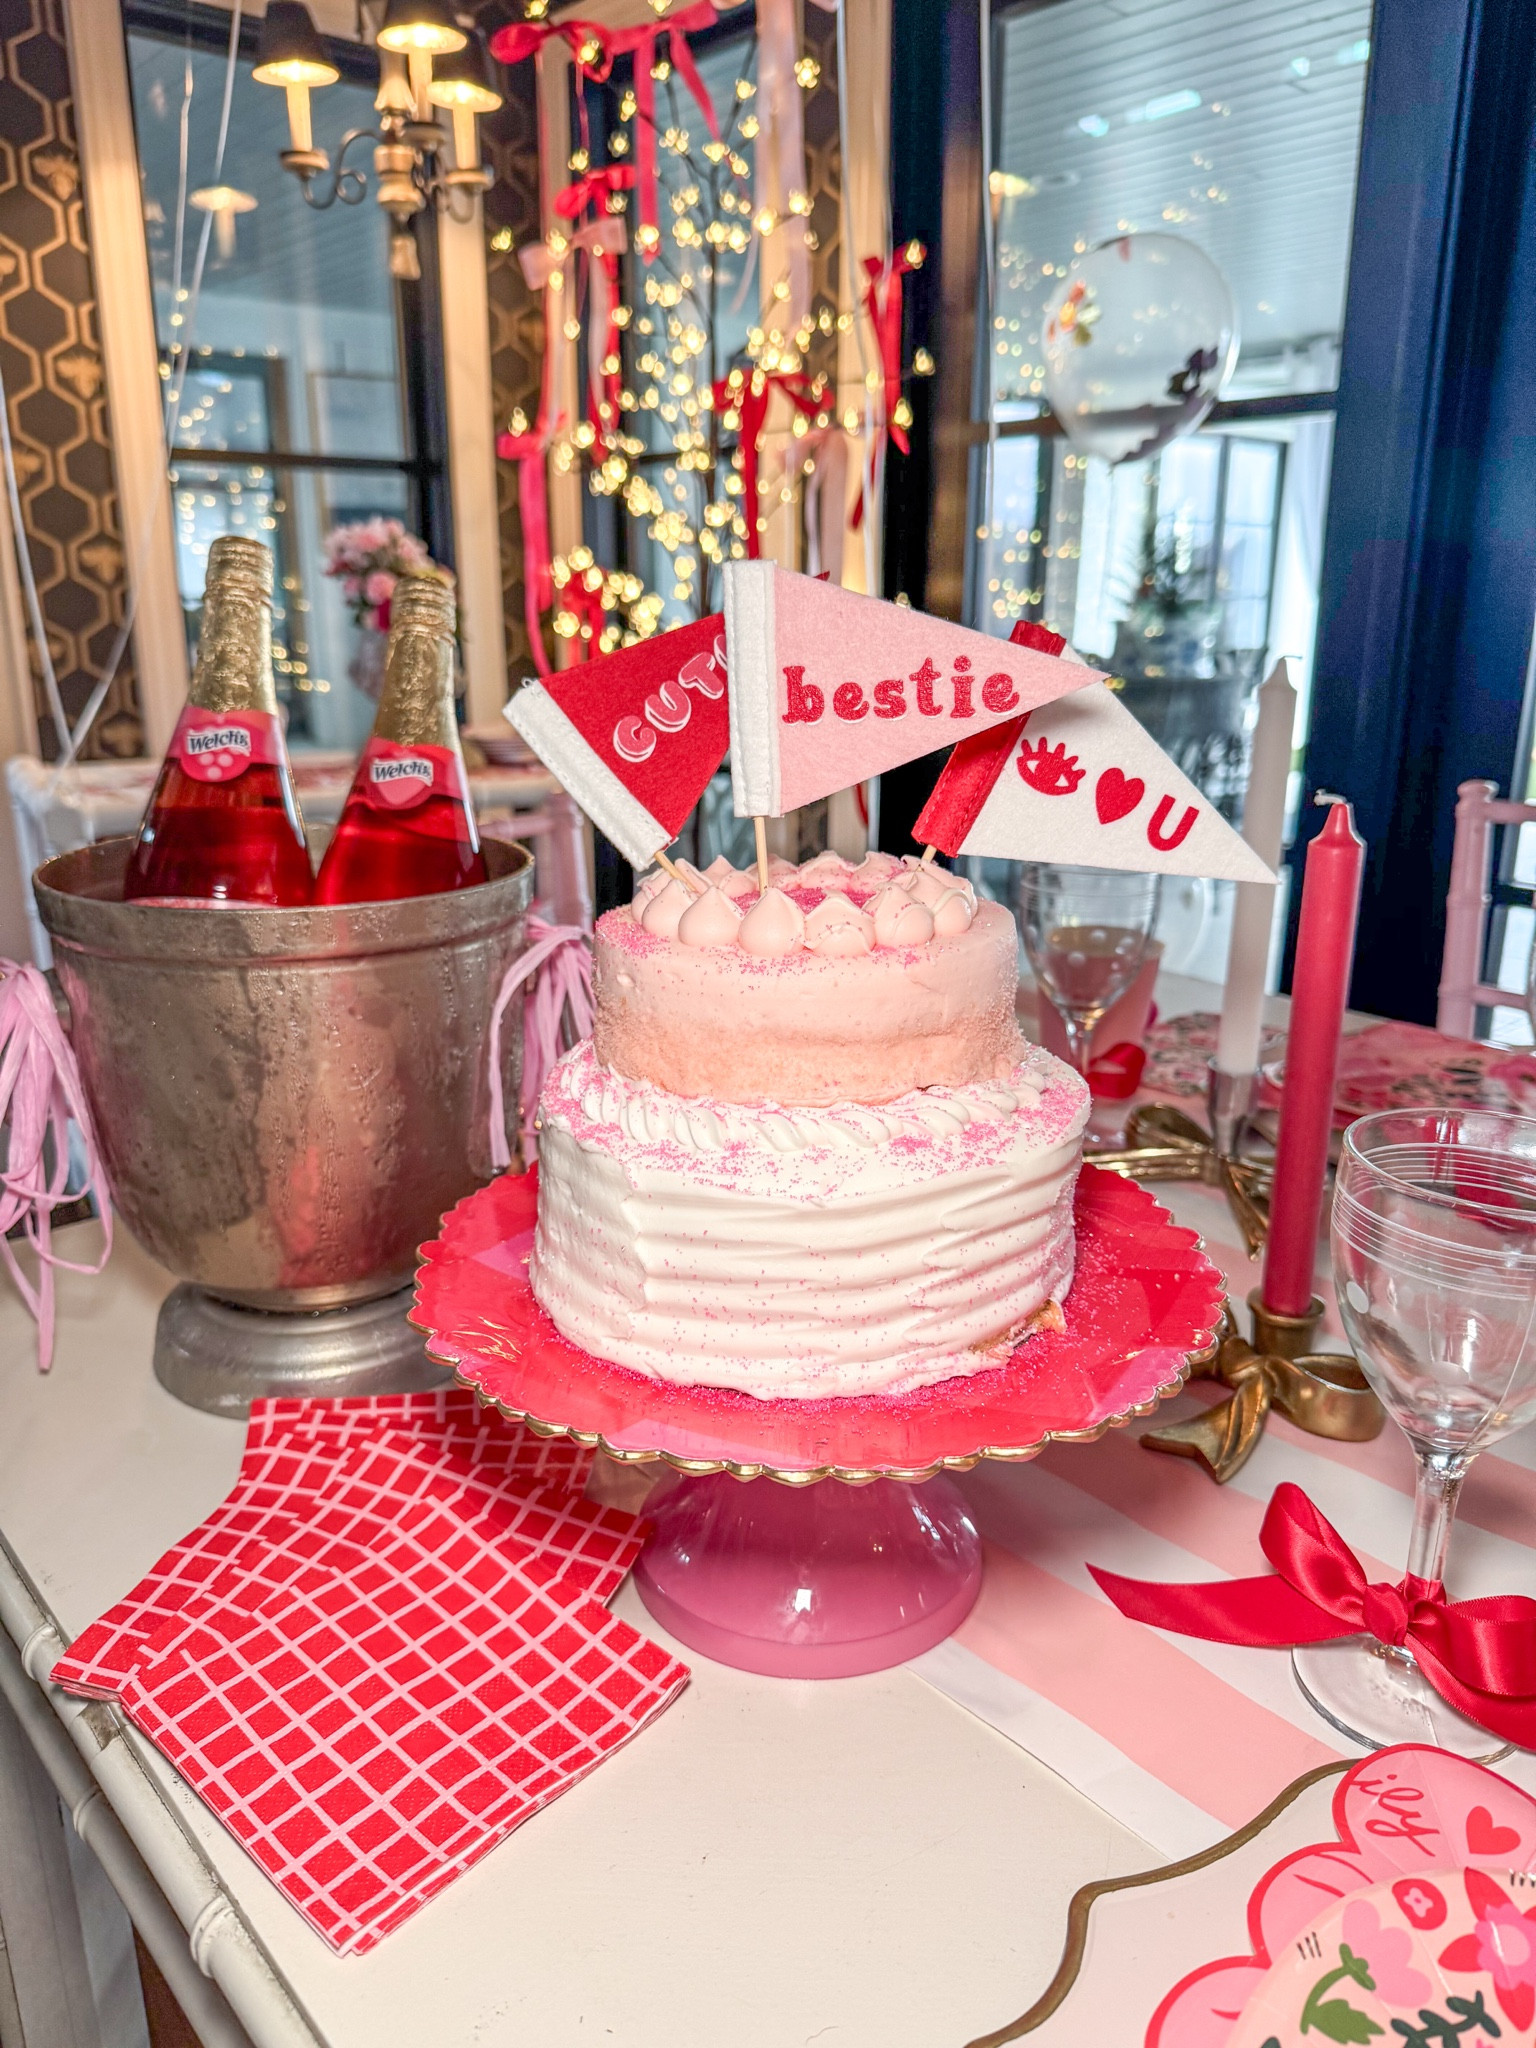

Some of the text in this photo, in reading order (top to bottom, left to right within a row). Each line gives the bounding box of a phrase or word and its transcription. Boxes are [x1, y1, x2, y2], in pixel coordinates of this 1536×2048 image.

[782, 655, 1020, 725] bestie
[190, 730, 249, 753] Welch's
[375, 761, 431, 781] Welch's
[1147, 794, 1200, 851] U
[1350, 1774, 1440, 1857] ily
